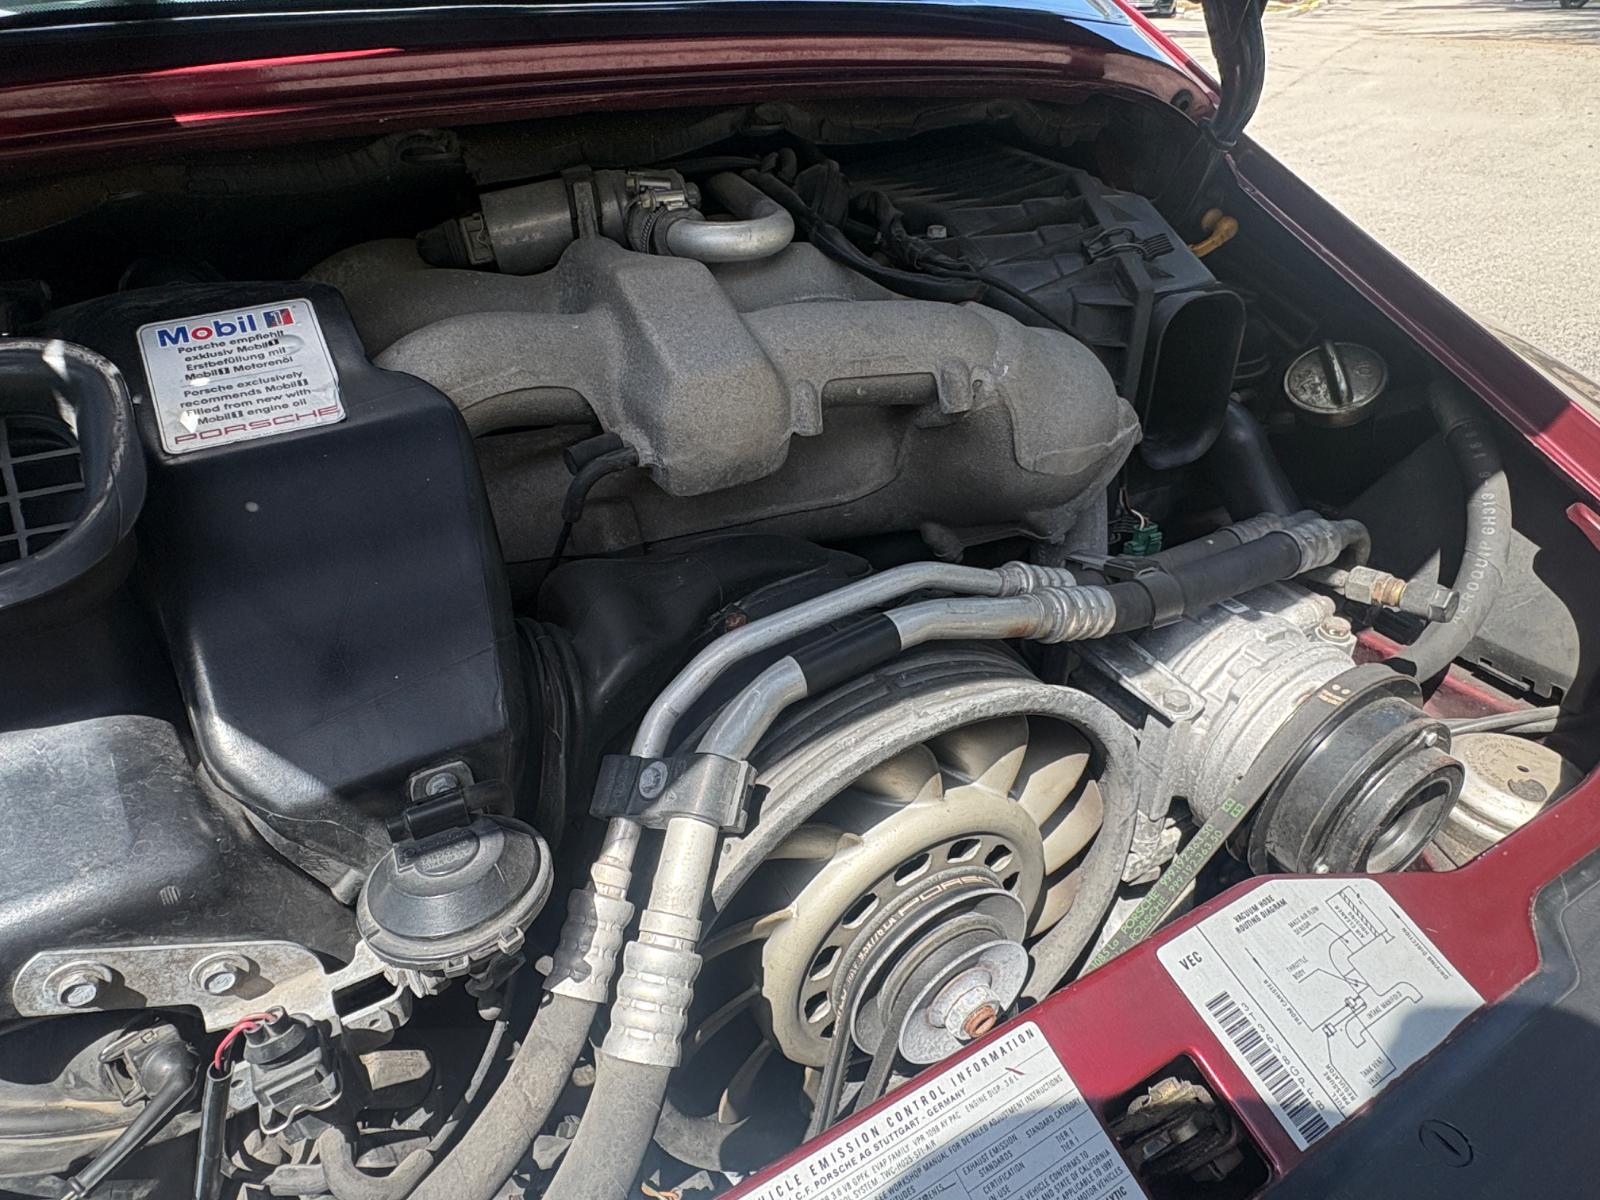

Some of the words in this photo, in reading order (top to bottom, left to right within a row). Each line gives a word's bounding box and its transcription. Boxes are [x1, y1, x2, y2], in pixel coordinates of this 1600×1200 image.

[156, 314, 257, 348] Mobil
[178, 340, 226, 354] Porsche
[229, 330, 284, 348] empfiehlt
[184, 346, 234, 362] exklusiv
[186, 352, 266, 372] Erstbefüllung
[268, 346, 286, 359] mit
[233, 356, 294, 374] Motorenöl
[180, 388, 262, 408] recommends
[184, 383, 234, 398] Porsche
[237, 370, 303, 390] exclusively
[186, 404, 221, 418] Filled
[224, 396, 253, 410] from
[256, 394, 283, 406] new
[285, 388, 312, 400] with
[246, 402, 290, 418] engine
[292, 398, 308, 409] oil
[174, 404, 339, 445] PORSCHE
[1452, 541, 1493, 630] AEROQUIP
[1120, 889, 1160, 934] PORSCHE
[1160, 823, 1214, 886] 999.192.363.50
[1128, 896, 1168, 942] PORSCHE
[1168, 830, 1224, 892] 999.192.363.50
[1232, 903, 1260, 924] VACUUM
[1258, 894, 1275, 911] HOSE
[1234, 912, 1262, 934] ROUTING
[1260, 898, 1288, 920] DIAGRAM
[1288, 917, 1301, 929] MASS
[1300, 912, 1310, 921] AIR
[1334, 904, 1356, 929] CLEANER
[1347, 911, 1370, 936] HOUSING
[1293, 920, 1312, 936] SENSOR
[1354, 926, 1366, 939] AIR
[1401, 927, 1428, 957] DIRECTION
[1178, 950, 1203, 971] VEC
[1286, 955, 1309, 974] THROTTLE
[1426, 956, 1450, 980] DRIVING
[1264, 978, 1288, 1007] CANISTER
[1366, 1006, 1382, 1020] INTAKE
[1380, 990, 1403, 1010] MANIFOLD
[1286, 1008, 1303, 1026] FROM
[1360, 1066, 1374, 1078] TANK
[1372, 1056, 1384, 1070] VENT
[1366, 1072, 1382, 1086] VALVE
[1322, 1070, 1350, 1106] PRESSURE
[1325, 1064, 1356, 1102] REGULATOR
[808, 1125, 880, 1176] EMISSION
[886, 1086, 946, 1128] CONTROL
[950, 1028, 1035, 1087] INFORMATION
[1331, 1092, 1346, 1110] FUEL
[1025, 1114, 1055, 1139] STANDARD
[1054, 1097, 1082, 1120] CATEGORY
[814, 1156, 858, 1189] PORSCHE
[858, 1148, 872, 1161] AG
[873, 1116, 920, 1152] STUTTGART
[926, 1087, 966, 1117] GERMANY
[842, 1181, 852, 1193] V8
[852, 1170, 870, 1187] GPFK
[871, 1158, 888, 1174] EVAP
[912, 1134, 926, 1148] VPR
[926, 1124, 940, 1138] 1098
[940, 1119, 948, 1130] AY
[948, 1112, 962, 1124] PAC
[964, 1093, 988, 1113] ENGINE
[887, 1168, 922, 1196] WORKSHOP
[922, 1152, 949, 1173] MANUAL
[948, 1142, 962, 1155] FOR
[960, 1124, 990, 1147] DETAILED
[989, 1100, 1026, 1131] ADJUSTMENT
[1025, 1074, 1064, 1106] INSTRUCTIONS
[1054, 1130, 1070, 1144] TIER
[1060, 1139, 1076, 1153] TIER
[962, 1152, 988, 1176] EXHAUST
[988, 1132, 1018, 1159] EMISSION
[978, 1149, 1014, 1178] STANDARDS
[982, 1160, 1026, 1195] CERTIFICATION
[1024, 1178, 1050, 1200] VEHICLE
[1049, 1154, 1081, 1184] CONFORMS
[1080, 1150, 1089, 1162] TO
[1054, 1175, 1072, 1194] STATE
[1070, 1170, 1078, 1183] OF
[1078, 1148, 1111, 1176] CALIFORNIA
[1061, 1174, 1096, 1200] APPLICABLE
[1094, 1167, 1102, 1178] TO
[1101, 1158, 1115, 1172] 1997
[1078, 1184, 1099, 1200] MOTOR
